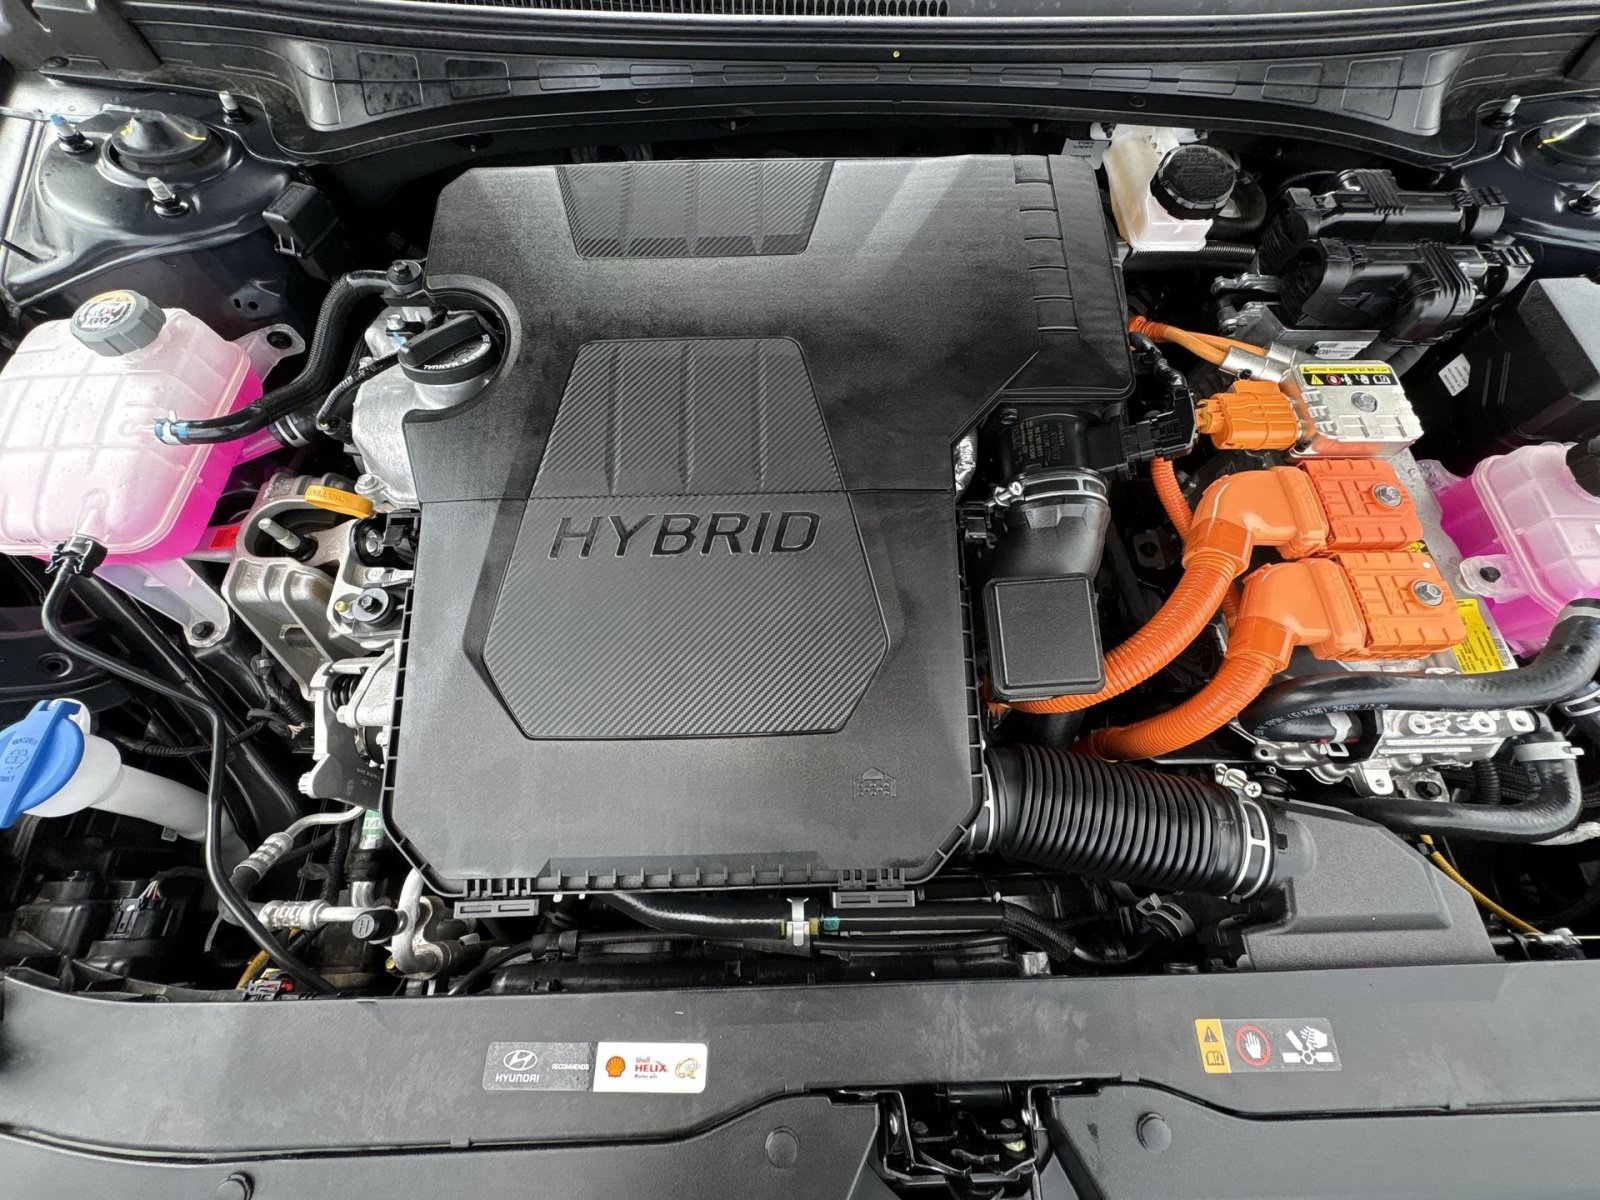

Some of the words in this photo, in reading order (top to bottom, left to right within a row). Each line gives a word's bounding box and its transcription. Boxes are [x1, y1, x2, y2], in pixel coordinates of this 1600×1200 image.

[423, 361, 459, 370] MANUAL
[547, 510, 821, 560] HYBRID
[635, 1056, 651, 1064] Shell
[551, 1063, 590, 1071] RECOMMENDS
[634, 1063, 668, 1074] HELIX
[495, 1072, 540, 1083] HYUNDAI
